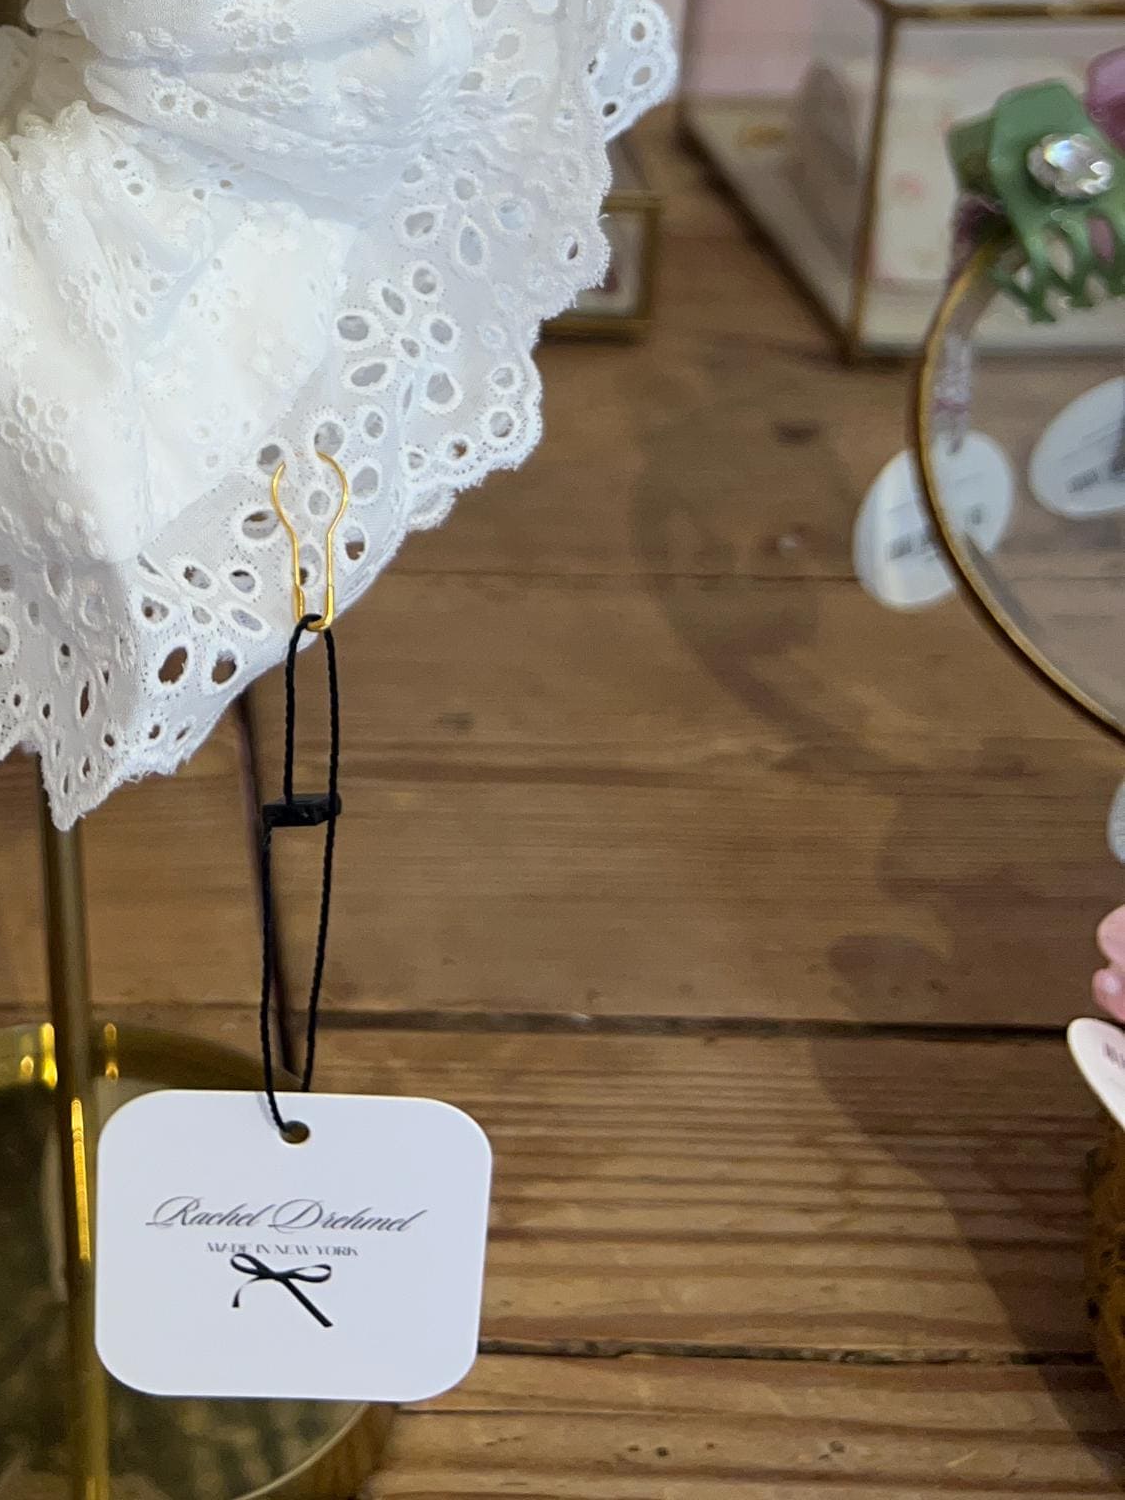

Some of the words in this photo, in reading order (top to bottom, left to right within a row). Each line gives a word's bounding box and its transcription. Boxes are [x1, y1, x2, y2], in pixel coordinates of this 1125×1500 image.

[145, 1196, 276, 1229] Rachel
[267, 1199, 428, 1234] Drehmel
[207, 1242, 249, 1253] MADE
[255, 1243, 271, 1254] IN
[275, 1244, 311, 1255] NEW
[315, 1245, 359, 1256] YORK
